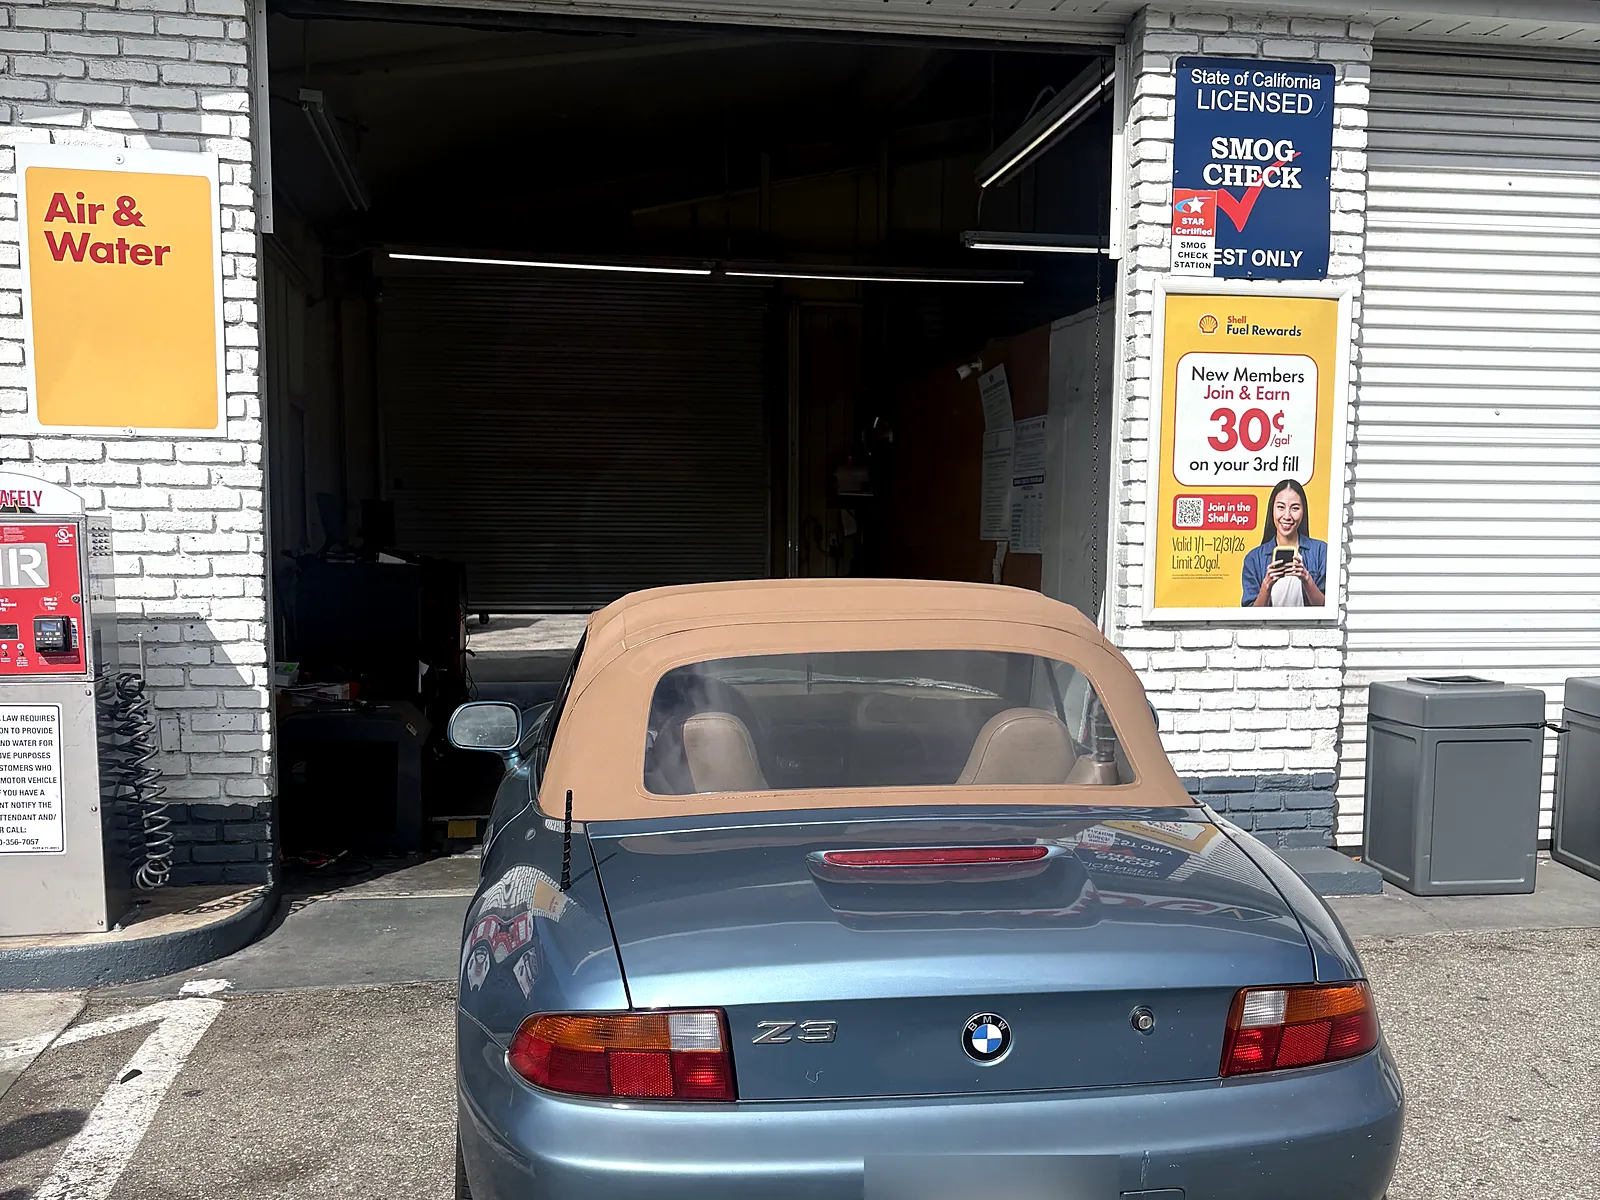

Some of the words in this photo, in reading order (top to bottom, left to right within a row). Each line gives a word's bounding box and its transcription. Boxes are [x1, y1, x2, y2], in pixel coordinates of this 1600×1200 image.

[1191, 68, 1230, 85] State
[1234, 70, 1250, 86] of
[1252, 71, 1321, 90] California
[1197, 88, 1313, 114] LICENSED
[1211, 136, 1295, 162] SMOG
[1203, 163, 1302, 189] CHECK
[43, 191, 105, 225] Air
[112, 195, 146, 228] &
[1181, 217, 1205, 226] STAR
[1175, 226, 1213, 236] Certified
[43, 230, 171, 266] Water
[1180, 241, 1206, 249] SMOG
[1177, 251, 1208, 259] CHECK
[1214, 248, 1248, 266] EST
[1251, 249, 1304, 268] ONLY
[1173, 260, 1212, 269] STATION
[1227, 315, 1247, 324] Shell
[1226, 324, 1249, 336] Fuel
[1252, 325, 1302, 337] Rewards
[1191, 366, 1229, 381] New
[1233, 366, 1305, 383] Members
[1203, 385, 1234, 400] Join
[1239, 385, 1251, 401] &
[1256, 386, 1290, 401] Earn
[1189, 460, 1209, 471] on
[1214, 460, 1250, 476] your
[1253, 456, 1278, 472] 3rd
[1282, 456, 1299, 472] fill
[1207, 502, 1226, 512] Join
[1227, 502, 1237, 512] in
[1237, 501, 1251, 512] the
[1207, 512, 1229, 523] Shell
[1229, 514, 1249, 525] App
[1172, 535, 1192, 552] Valid
[0, 548, 47, 586] IR
[1172, 555, 1193, 570] Limit
[2, 714, 19, 722] LAW
[20, 714, 56, 722] REQUIRES
[12, 739, 37, 747] WATER
[38, 739, 54, 747] FOR
[0, 776, 26, 784] MOTOR
[27, 776, 58, 784] VEHICLE
[11, 801, 37, 809] NOTIFY
[38, 801, 52, 809] THE
[38, 813, 57, 821] AND/
[967, 1015, 1008, 1032] BMW
[752, 1019, 839, 1045] Z3
